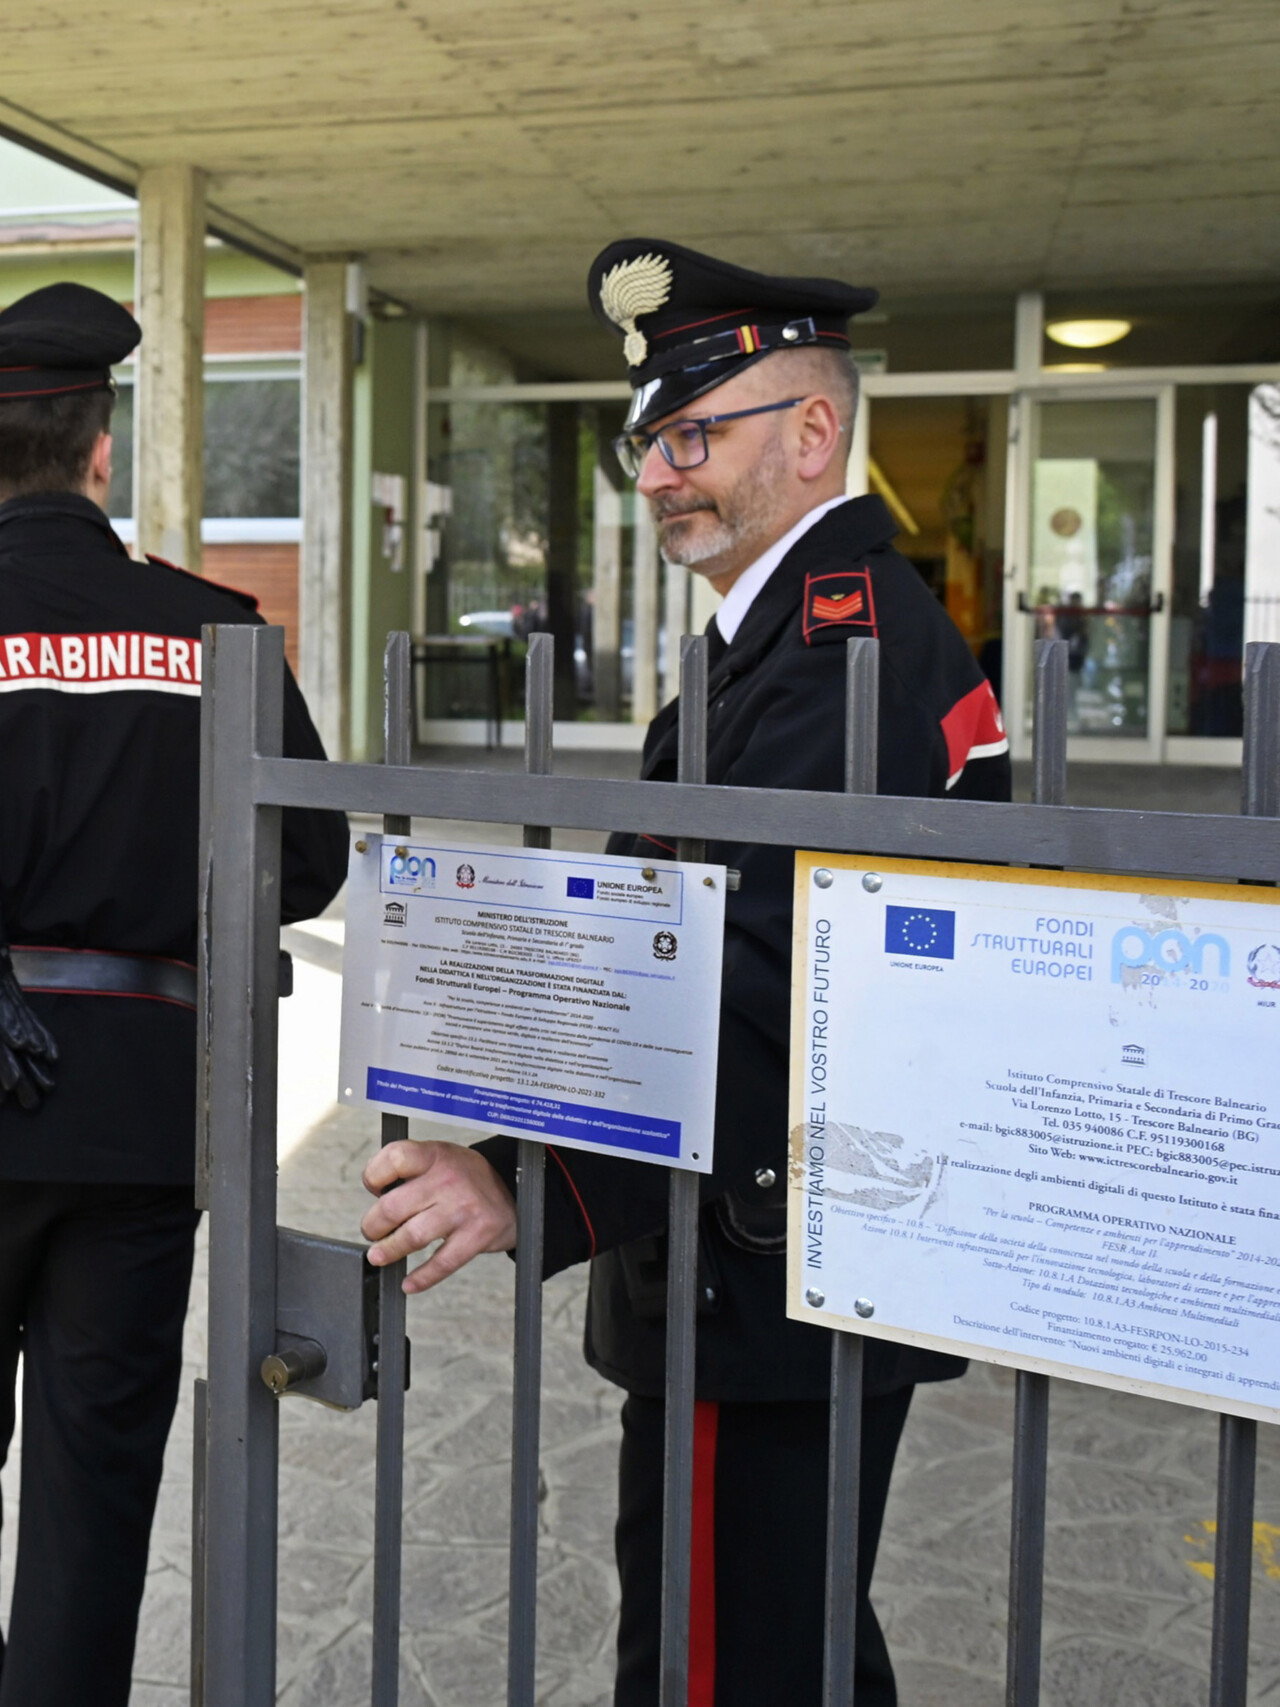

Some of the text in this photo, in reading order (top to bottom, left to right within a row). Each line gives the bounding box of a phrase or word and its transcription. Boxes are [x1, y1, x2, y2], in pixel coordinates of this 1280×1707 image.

[596, 880, 664, 895] UNIONE EUROPEA
[434, 915, 615, 945] ISTITUTO COMPRENSIVO STATALE DI TRESCORE BALNEARIO
[476, 910, 569, 929] MINISTERO DELL'ISTRUZIONE
[1035, 916, 1094, 938] FONDI
[969, 932, 1094, 960] STRUTTURALI
[1110, 926, 1231, 984] pon
[1010, 957, 1093, 982] EUROPEI
[414, 974, 631, 1013] Fondi Strutturali Europei Programma Operativo Nazionale
[436, 1063, 455, 1074] Codice
[454, 1067, 490, 1080] identificativo
[489, 1073, 516, 1084] progetto:
[807, 919, 831, 1269] INVESTIAMO NEL VOSTRO FUTURO
[984, 1079, 1254, 1127] Scuola dell'Infanzia, Primaria e Secondaria di Primo
[1007, 1067, 1268, 1113] Istituto Comprensivo Statale di Trescore Balneario
[1011, 1097, 1029, 1110] Via
[1030, 1099, 1073, 1116] Lorenzo
[1073, 1106, 1107, 1122] Lotto,
[1130, 1114, 1176, 1131] Trescore
[1176, 1121, 1230, 1139] Balneario
[1231, 1129, 1260, 1144] (BG)
[1041, 1115, 1061, 1129] Tel.
[1125, 1128, 1148, 1142] C.F.
[958, 1121, 993, 1133] e-mail:
[1125, 1143, 1154, 1158] PEC:
[1028, 1142, 1049, 1156] Sito
[1049, 1146, 1077, 1160] Web:
[950, 1159, 1013, 1177] realizzazione
[1013, 1167, 1039, 1183] degli
[1039, 1174, 1086, 1189] ambienti
[1087, 1180, 1125, 1196] digitali
[1126, 1186, 1139, 1198] di
[1140, 1191, 1177, 1204] questo
[1178, 1194, 1219, 1211] Istituto
[1220, 1201, 1228, 1212] è
[1229, 1205, 1256, 1217] stata
[1028, 1201, 1237, 1246] PROGRAMMA OPERATIVO NAZIONALE
[1009, 1301, 1041, 1316] Codice
[1041, 1309, 1081, 1324] progetto:
[952, 1314, 1002, 1334] Descrizione
[1001, 1325, 1067, 1348] dell'intervento:
[1101, 1347, 1142, 1363] ambienti
[1142, 1354, 1176, 1370] digitali
[1176, 1363, 1183, 1372] e
[1184, 1363, 1224, 1380] integrati
[1224, 1371, 1236, 1383] di
[1047, 1320, 1112, 1343] Finanziamento
[1112, 1337, 1150, 1352] erogato:
